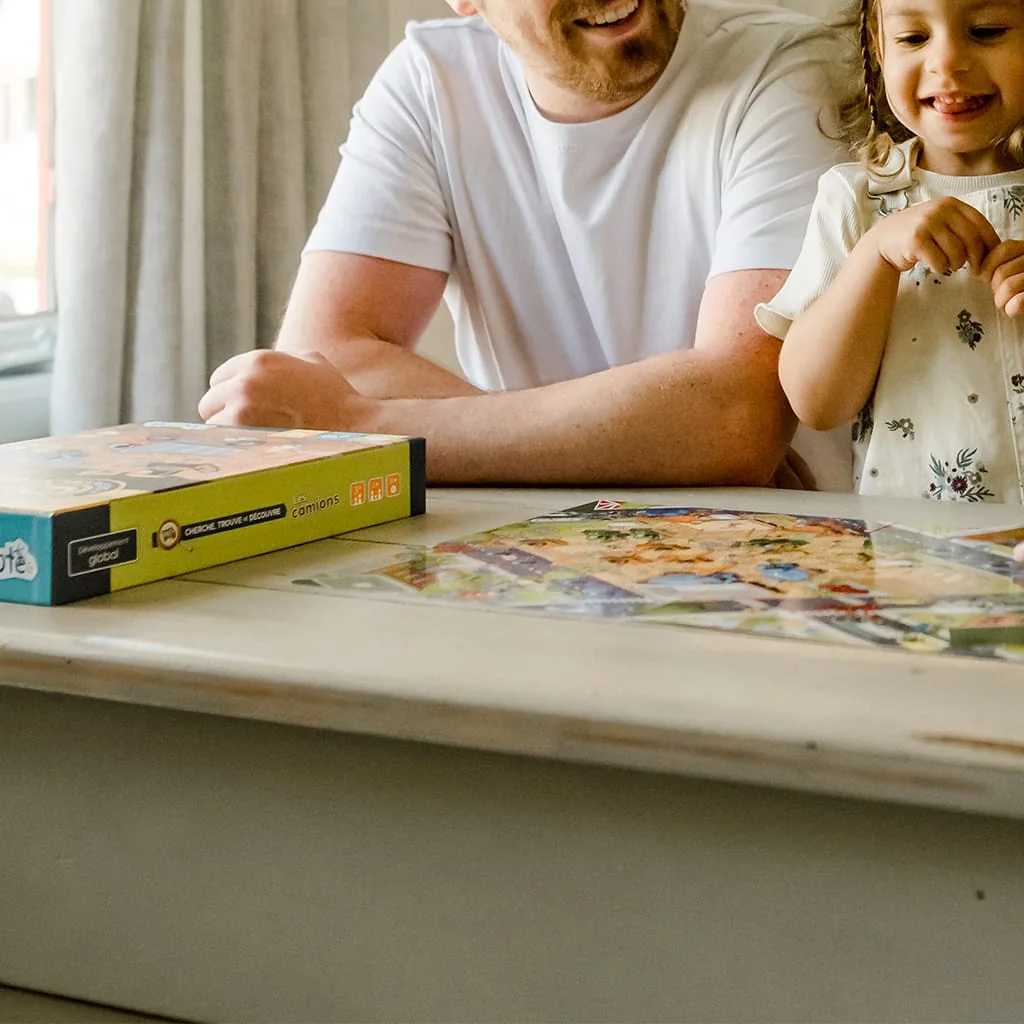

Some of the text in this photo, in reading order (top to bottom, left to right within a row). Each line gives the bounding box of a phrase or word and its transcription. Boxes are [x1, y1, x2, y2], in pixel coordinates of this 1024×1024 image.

[291, 494, 339, 518] camions
[217, 517, 242, 528] TROUVE
[88, 548, 119, 568] global
